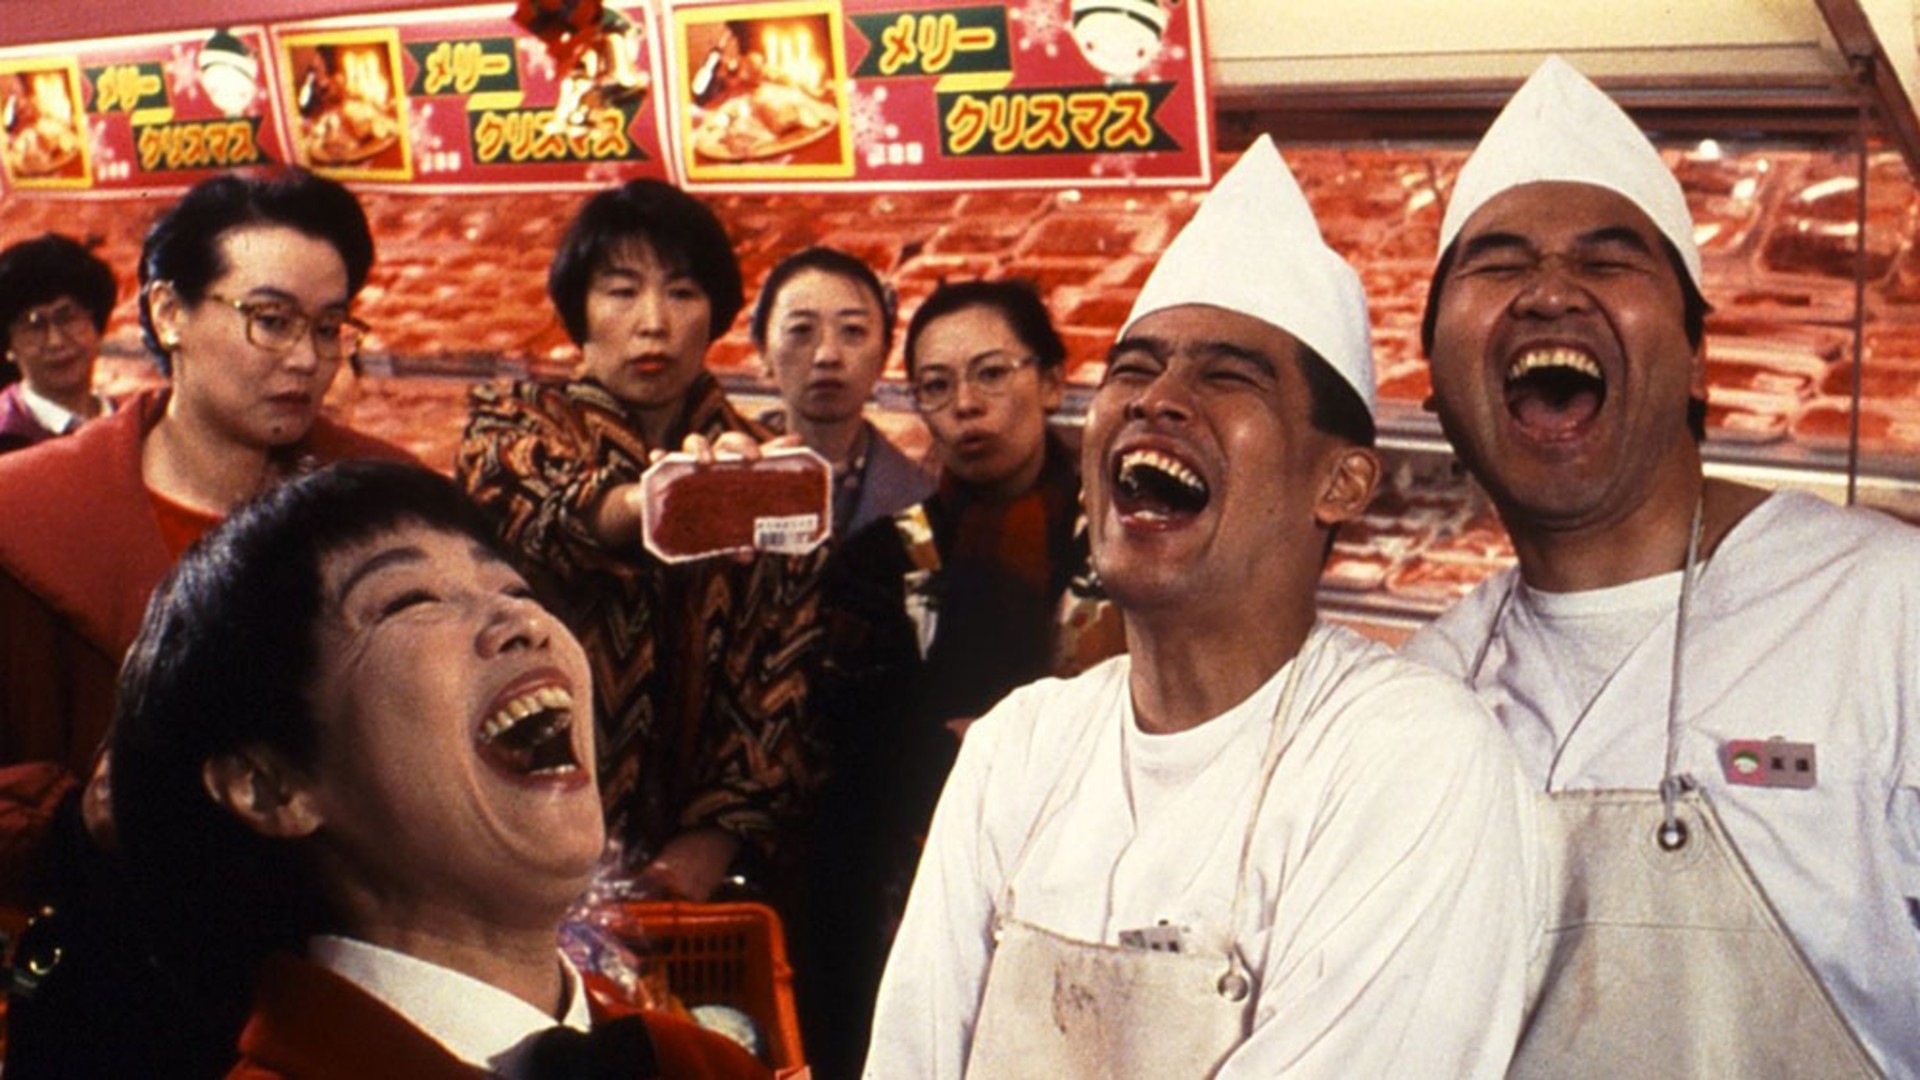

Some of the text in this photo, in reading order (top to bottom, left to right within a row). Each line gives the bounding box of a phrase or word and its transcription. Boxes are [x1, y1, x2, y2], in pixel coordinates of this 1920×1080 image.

[424, 41, 511, 93] メリー
[879, 14, 996, 74] メリー
[139, 120, 258, 169] クリスマス
[946, 91, 1152, 154] クリスマス
